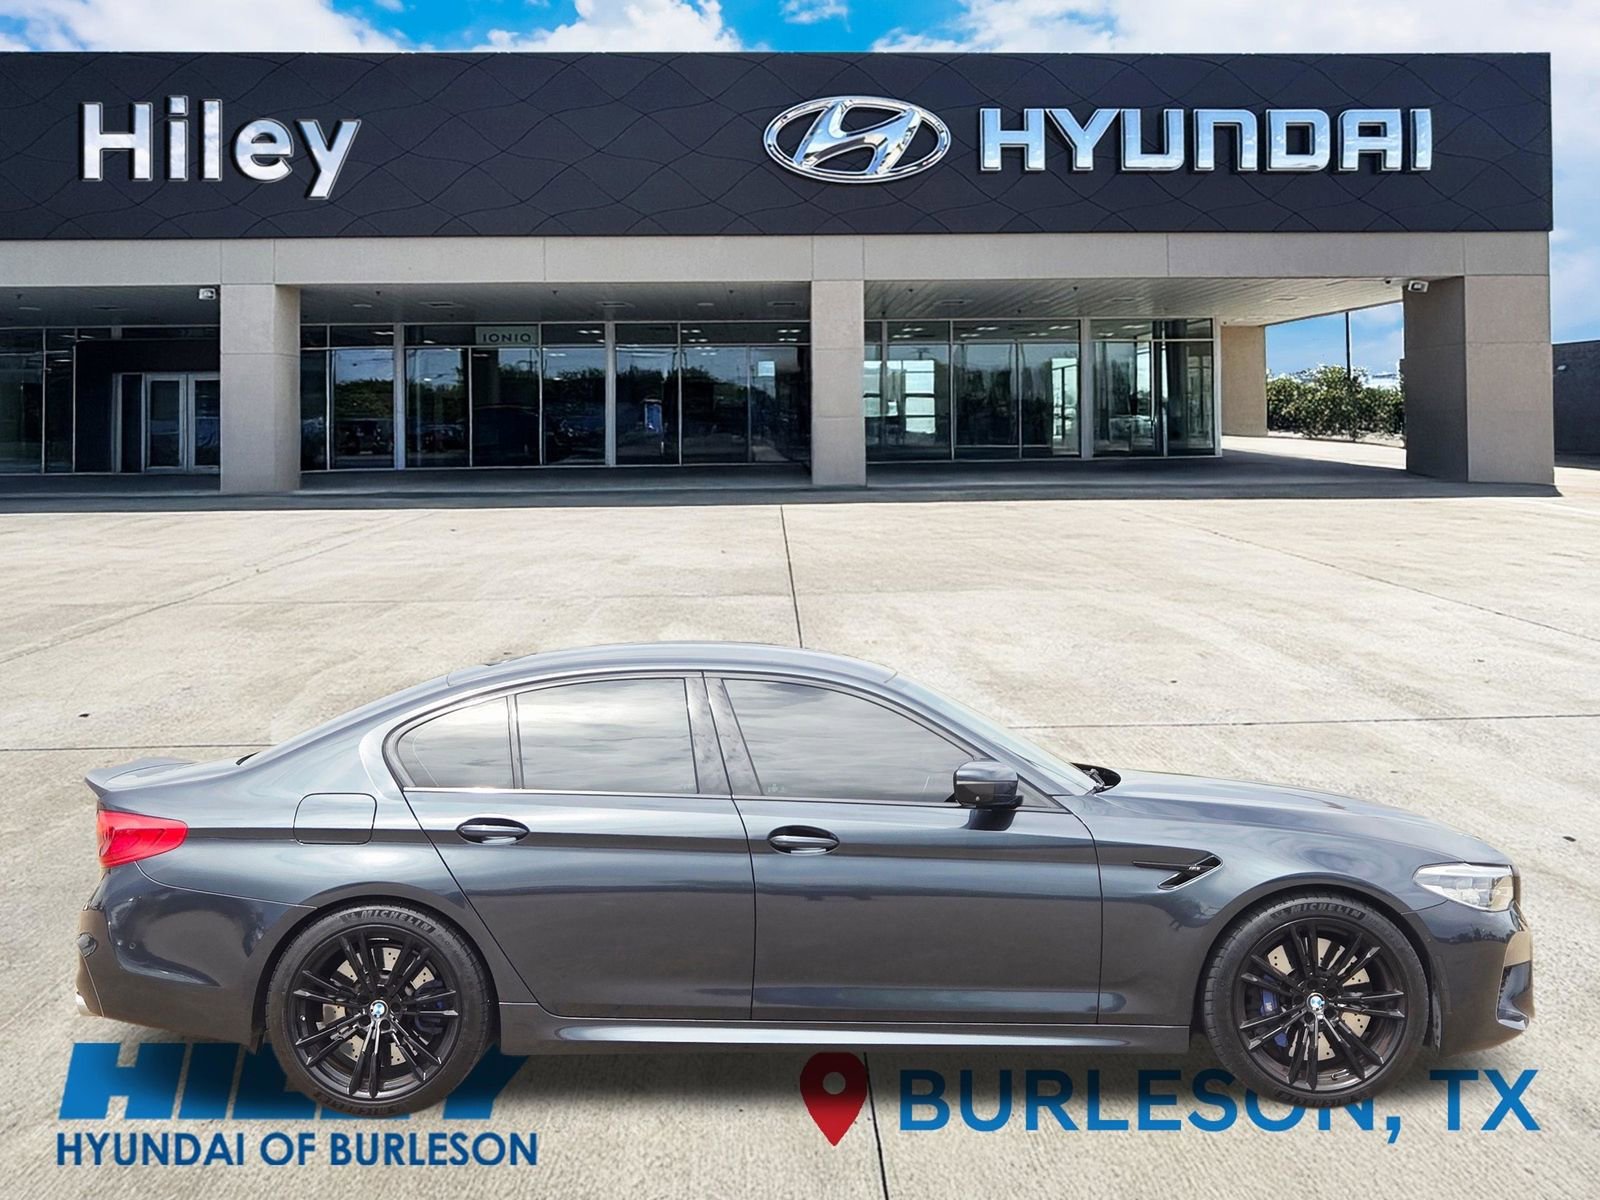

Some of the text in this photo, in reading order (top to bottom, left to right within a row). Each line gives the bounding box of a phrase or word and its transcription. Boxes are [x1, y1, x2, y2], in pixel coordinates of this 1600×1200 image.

[80, 95, 362, 200] Hiley
[979, 107, 1432, 173] HYUNDAI
[360, 909, 432, 933] MICHELIN
[1290, 902, 1363, 919] MICHELIN
